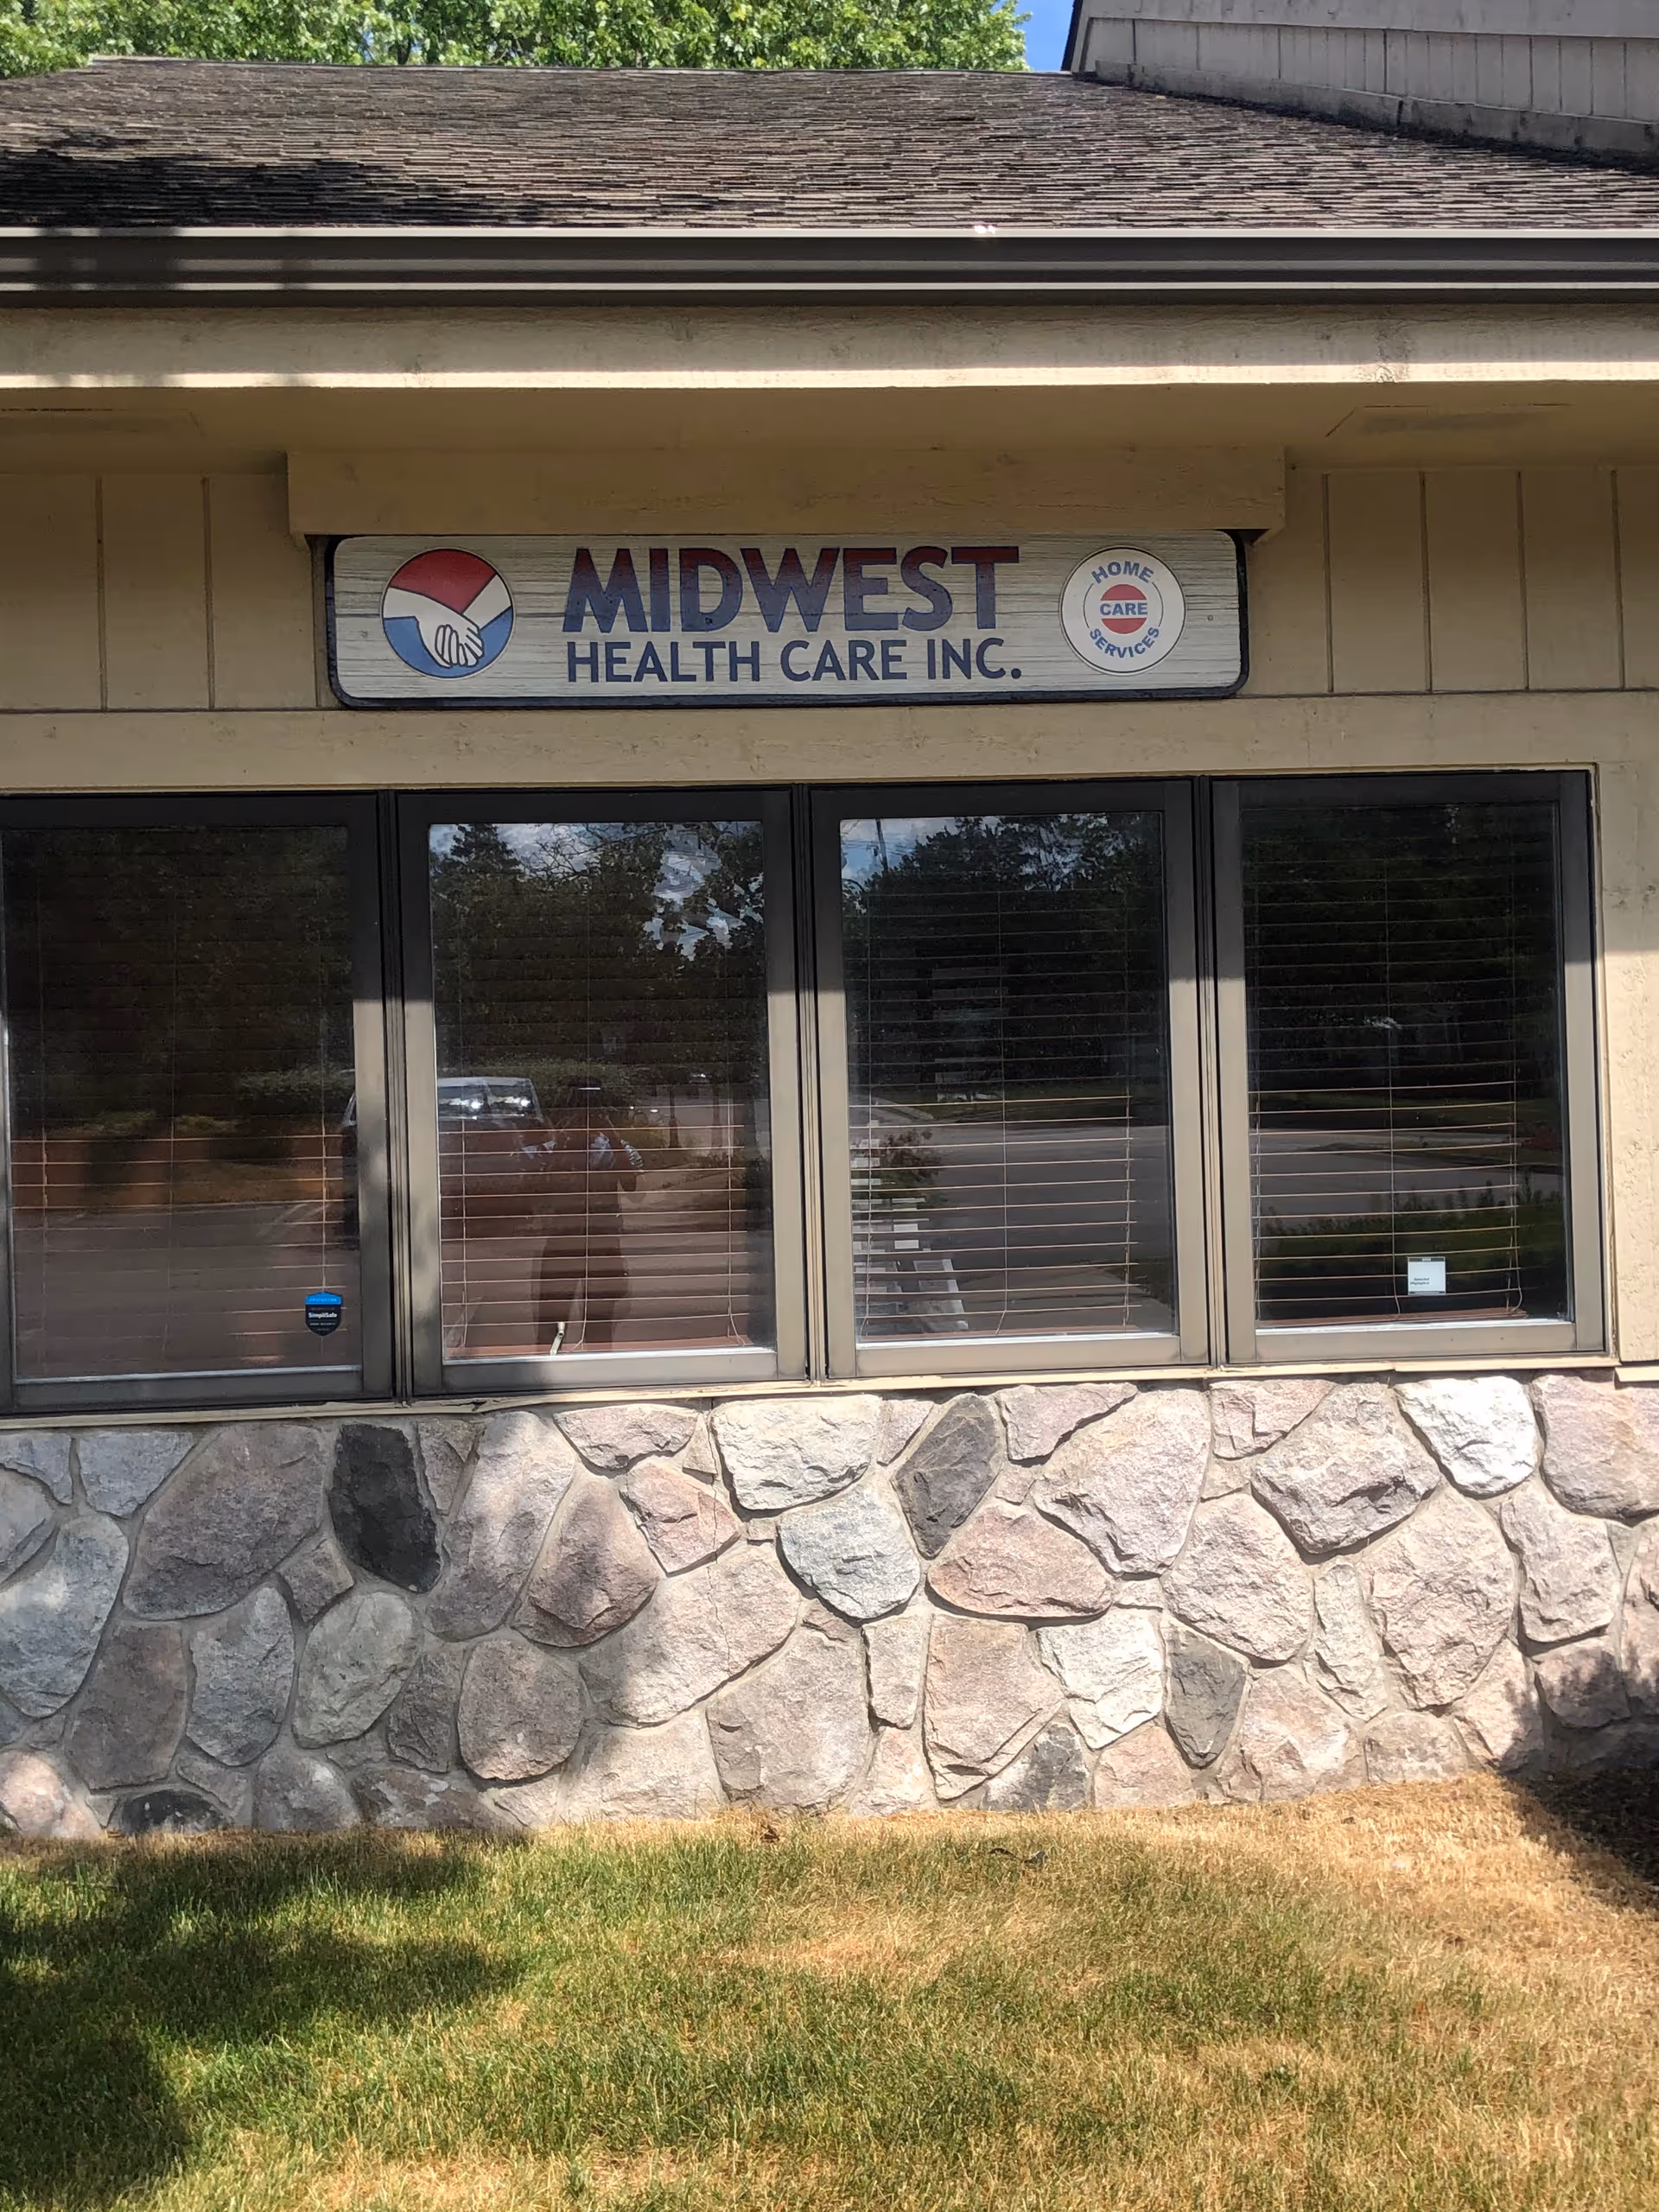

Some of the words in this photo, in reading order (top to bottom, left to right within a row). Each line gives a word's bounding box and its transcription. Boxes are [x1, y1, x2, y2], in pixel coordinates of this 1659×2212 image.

[1091, 561, 1154, 584] HOME
[563, 546, 1020, 633] MIDWEST
[1099, 602, 1148, 616] CARE
[1089, 626, 1160, 658] SERVICES
[567, 641, 760, 683] HEALTH
[780, 639, 907, 682] CARE
[927, 638, 1022, 679] INC.
